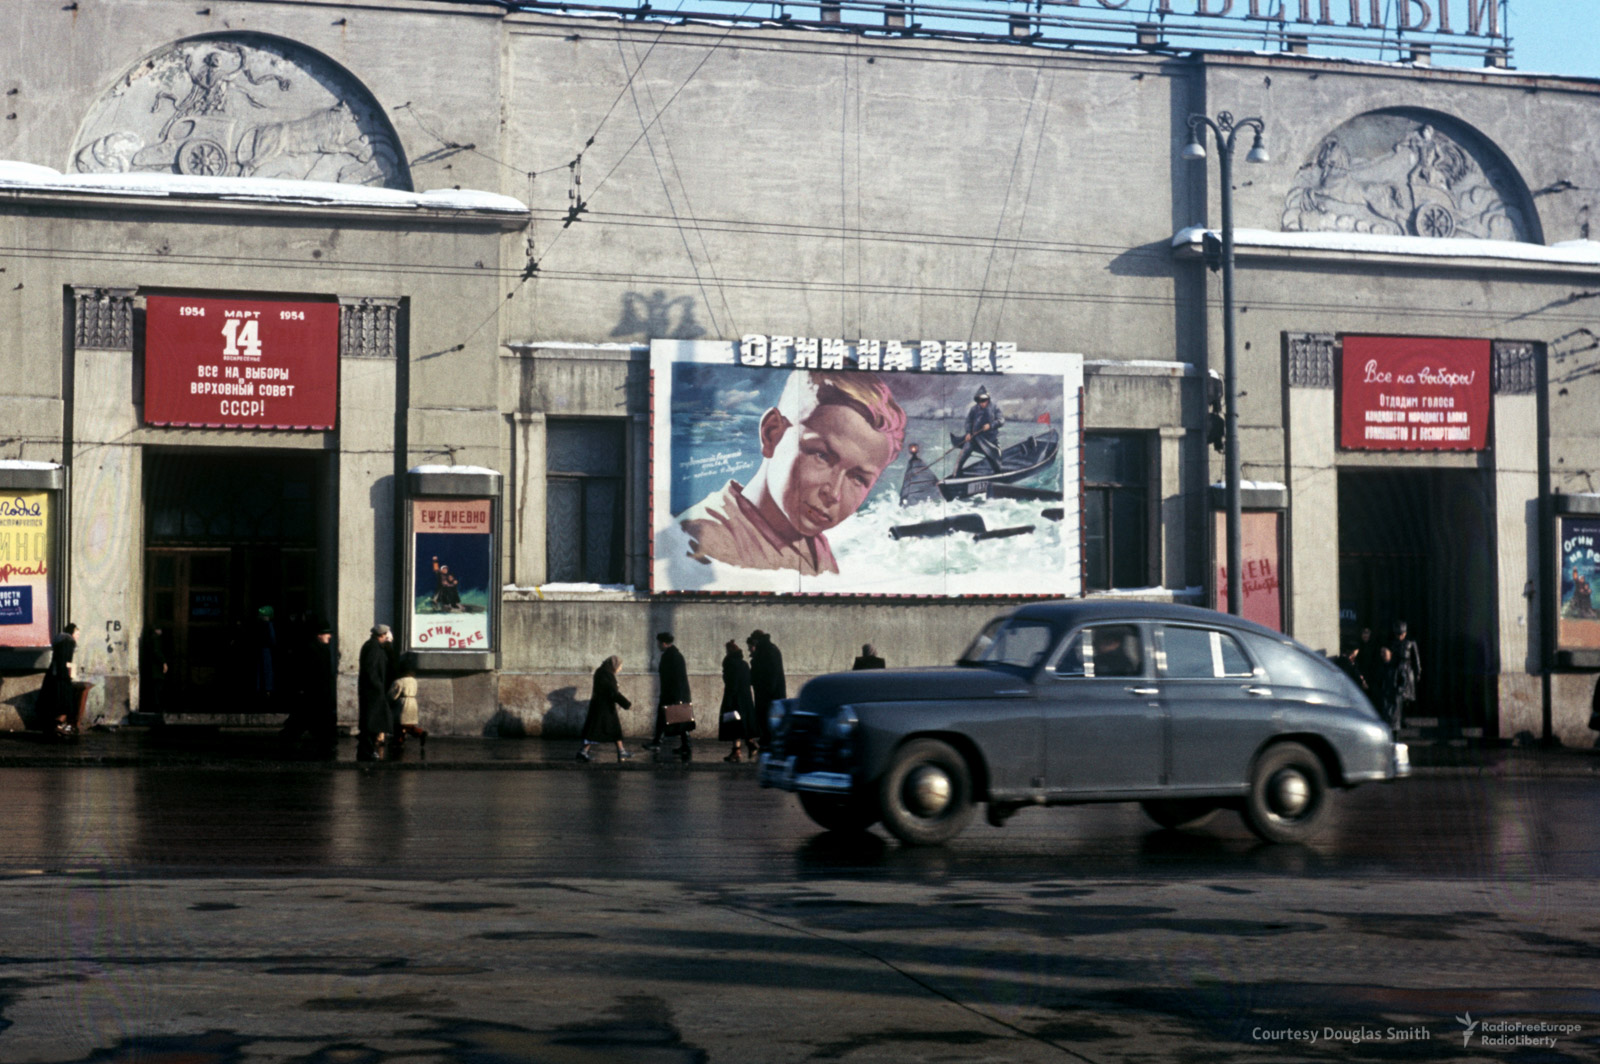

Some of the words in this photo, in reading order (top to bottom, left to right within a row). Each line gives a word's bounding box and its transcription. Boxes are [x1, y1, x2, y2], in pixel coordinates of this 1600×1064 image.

[179, 306, 205, 317] 1954
[224, 310, 261, 318] МАРТ
[280, 310, 305, 320] 1954
[221, 319, 262, 356] 14
[740, 333, 845, 370] ОГНИ
[857, 338, 908, 372] НА
[920, 340, 1018, 373] РЕКЕ
[225, 366, 239, 378] НА
[245, 367, 289, 380] ВЫБОРЫ
[1363, 359, 1392, 383] Все
[1397, 374, 1416, 384] на
[1417, 366, 1475, 388] выборы!
[220, 400, 265, 416] СССР!
[0, 497, 41, 516] годня
[421, 510, 486, 525] ЕЖЕДНЕВНО
[1564, 535, 1593, 552] ОГНИ
[106, 620, 122, 632] ГВ
[419, 625, 452, 643] ОГНИ
[448, 630, 484, 649] РЕКЕ
